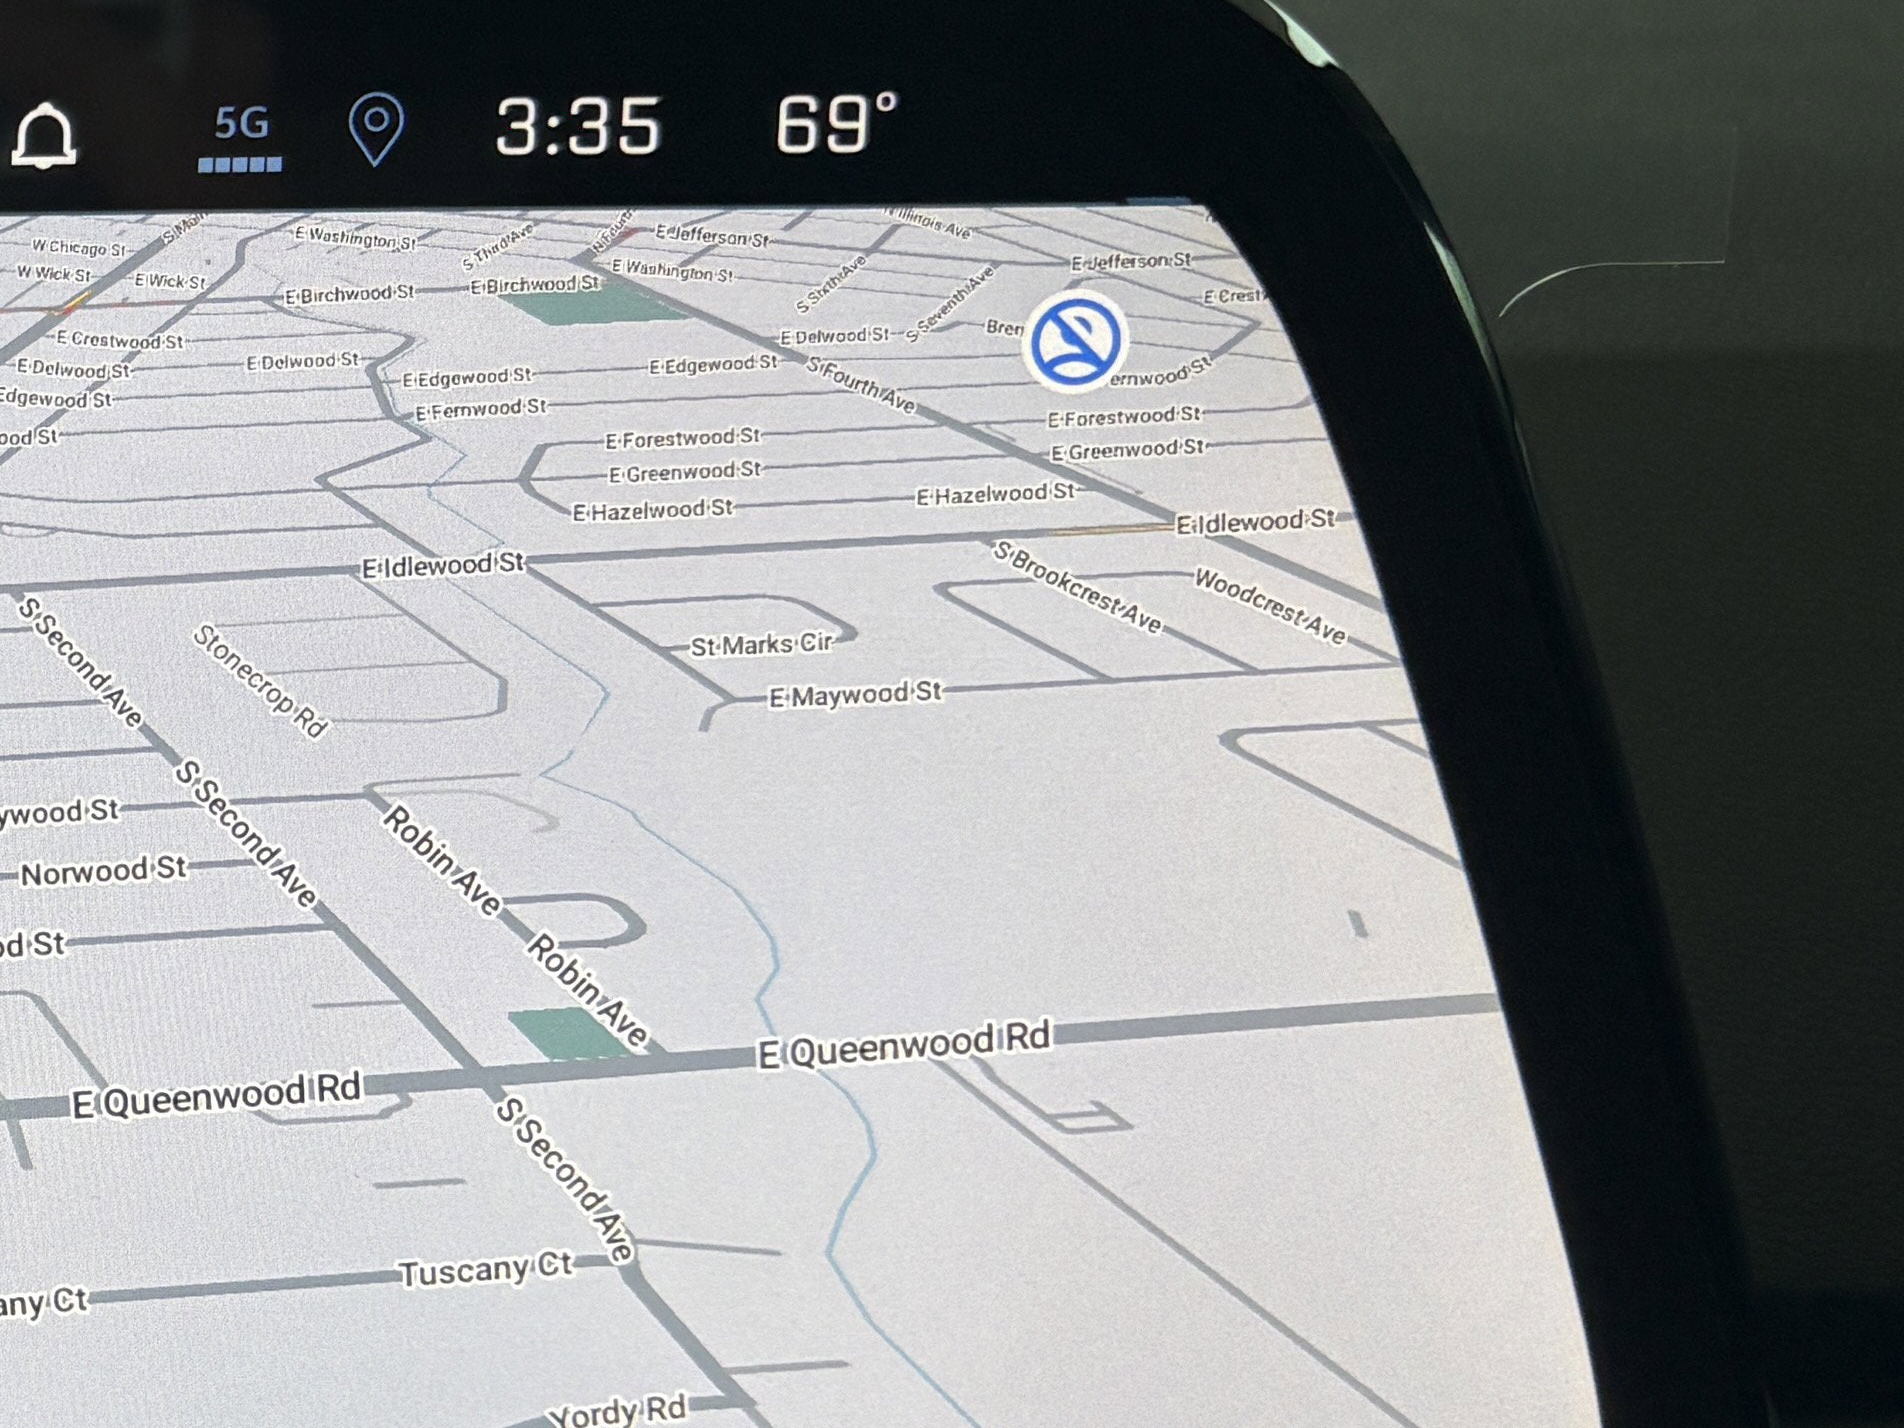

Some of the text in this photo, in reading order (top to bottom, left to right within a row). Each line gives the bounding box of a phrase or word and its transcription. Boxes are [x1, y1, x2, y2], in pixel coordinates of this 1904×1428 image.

[214, 105, 268, 139] 5G
[497, 96, 663, 155] 3:35
[777, 91, 898, 154] 69°
[472, 276, 599, 293] E Birchwood St
[651, 356, 777, 376] E Edgewood St
[808, 357, 915, 414] S Fourth Ave
[606, 428, 760, 448] E Forestwood St
[610, 461, 762, 482] E Greenwood St
[574, 500, 733, 521] E Hazelwood St
[917, 484, 1075, 505] E Hazelwood St
[1178, 510, 1335, 533] E Idlewood St
[363, 553, 524, 577] E Idlewood St
[995, 541, 1161, 634] S Brookcrest Ave
[1195, 569, 1346, 645] Woodcrest Ave
[691, 634, 832, 656] St Marks Cir
[20, 598, 143, 727] S Second Ave
[194, 624, 328, 740] Stonecrop Rd
[770, 682, 941, 708] E Maywood St
[91, 800, 118, 820] St
[177, 761, 316, 907] S Second Ave
[21, 856, 187, 886] Norwood St
[384, 806, 500, 916] Robin Ave
[34, 933, 64, 954] St
[527, 934, 647, 1047] Robin Ave
[760, 1021, 1050, 1068] E Queenwood Rd
[73, 1072, 360, 1118] E Queenwood Rd
[497, 1100, 632, 1262] S Second Ave
[398, 1252, 572, 1286] Tuscany Ct
[53, 1288, 87, 1311] Ct
[647, 1393, 685, 1421] Rd
